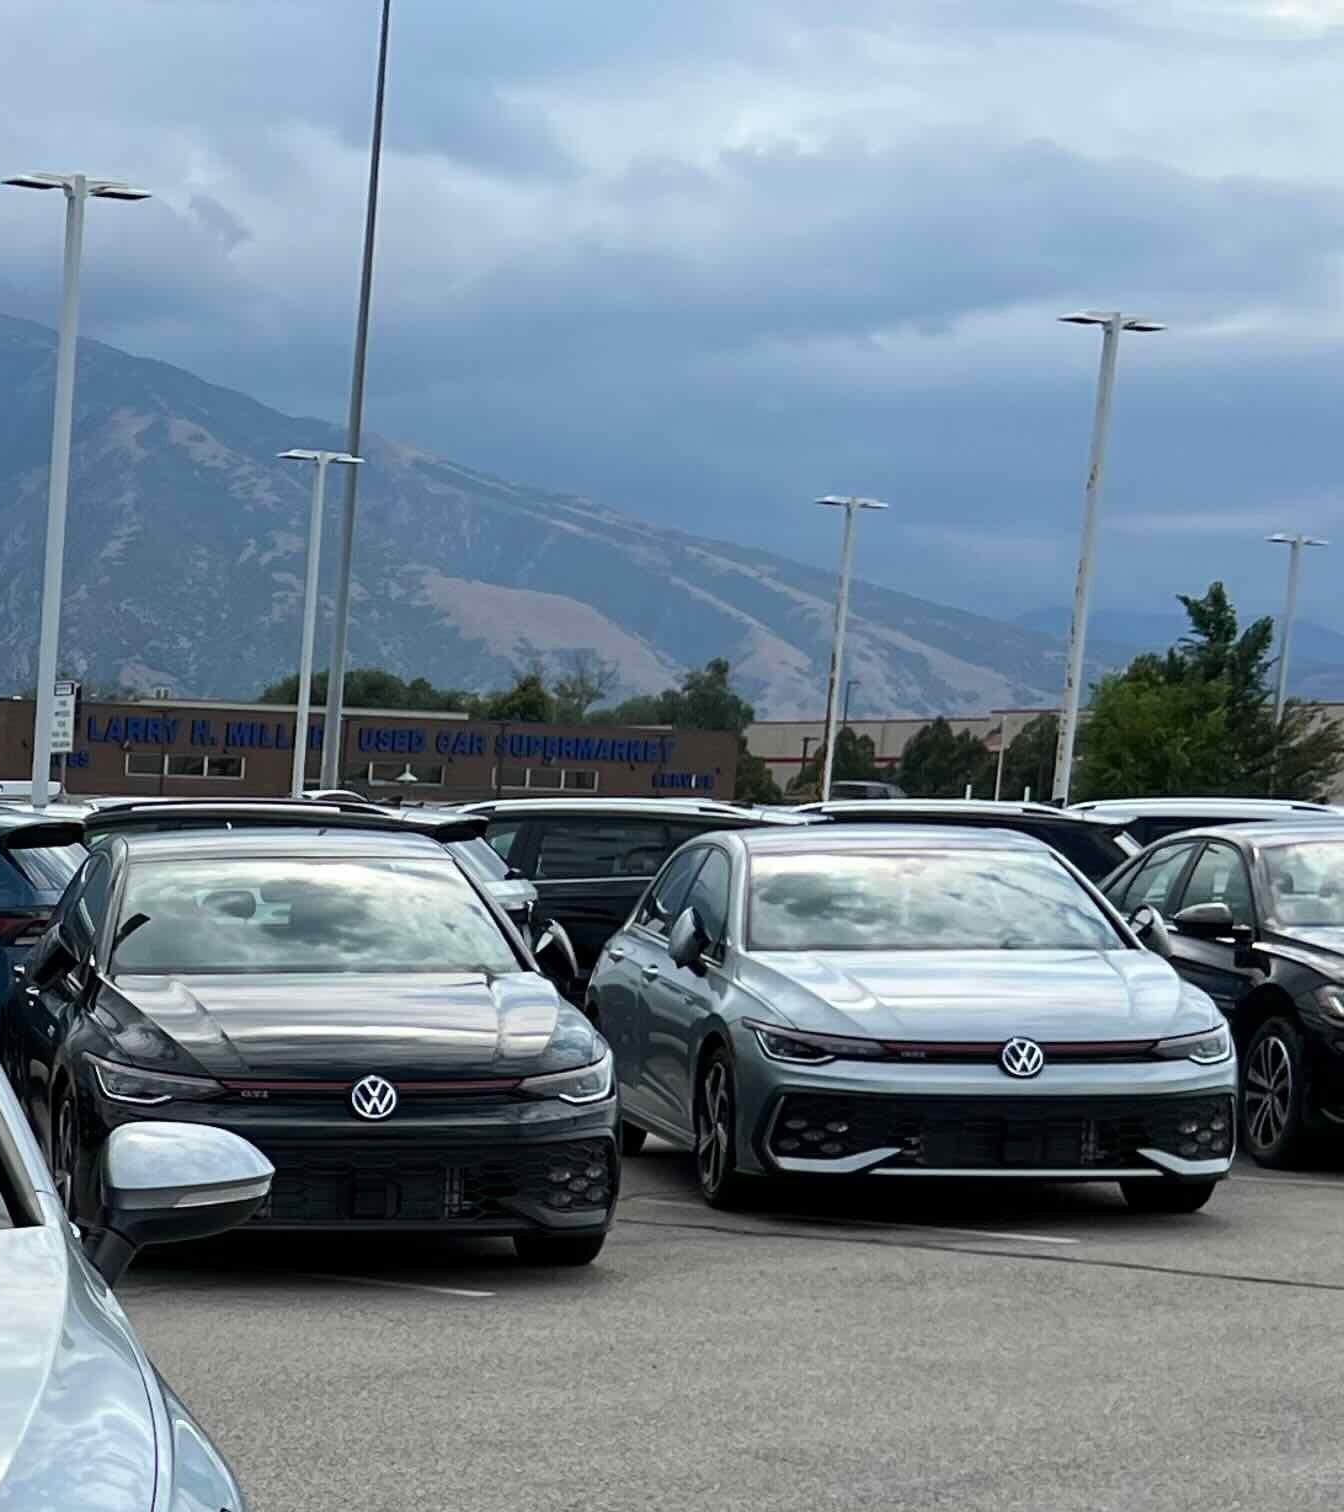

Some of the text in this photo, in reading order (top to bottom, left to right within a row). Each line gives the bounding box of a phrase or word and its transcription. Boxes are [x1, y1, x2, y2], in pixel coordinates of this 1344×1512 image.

[86, 715, 181, 745] LARRY
[358, 727, 427, 754] USED
[435, 729, 486, 757] CAR
[494, 733, 677, 763] SUPERMARKET
